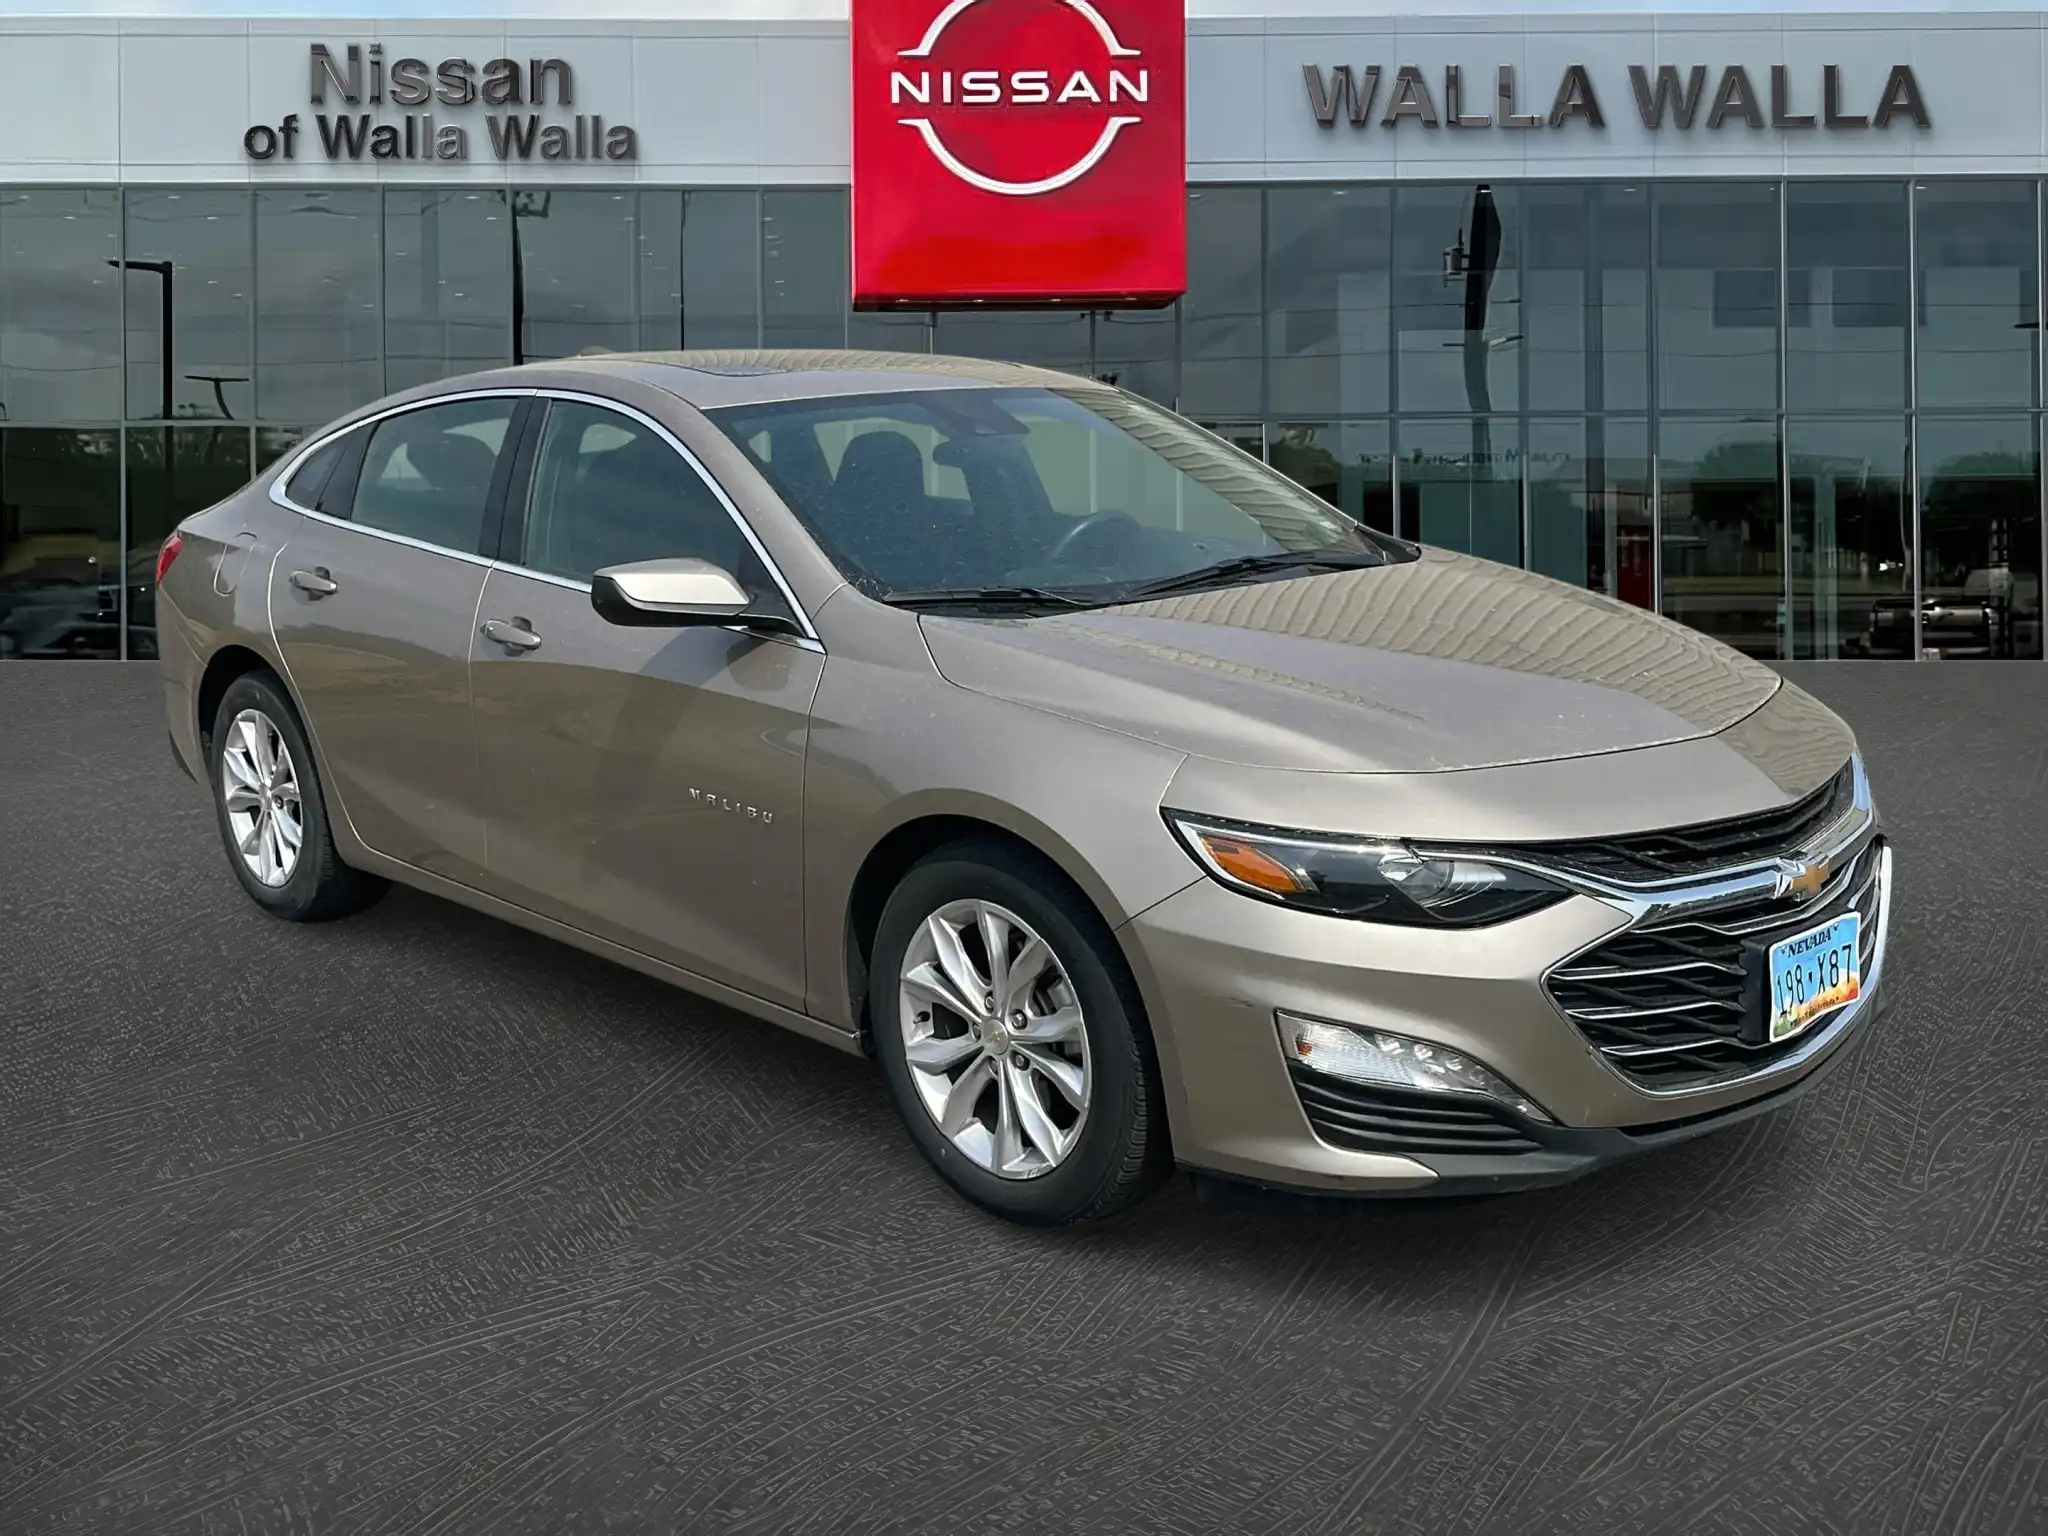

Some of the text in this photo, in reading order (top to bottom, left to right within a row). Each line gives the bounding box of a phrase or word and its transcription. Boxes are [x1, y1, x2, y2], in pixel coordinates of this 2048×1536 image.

[310, 41, 573, 106] Nissan
[891, 70, 1148, 104] NISSAN
[1301, 63, 1932, 128] WALLA WALLA
[243, 112, 637, 160] of Walla Walla
[688, 787, 773, 824] MALIBU
[1787, 927, 1832, 958] NEVADA
